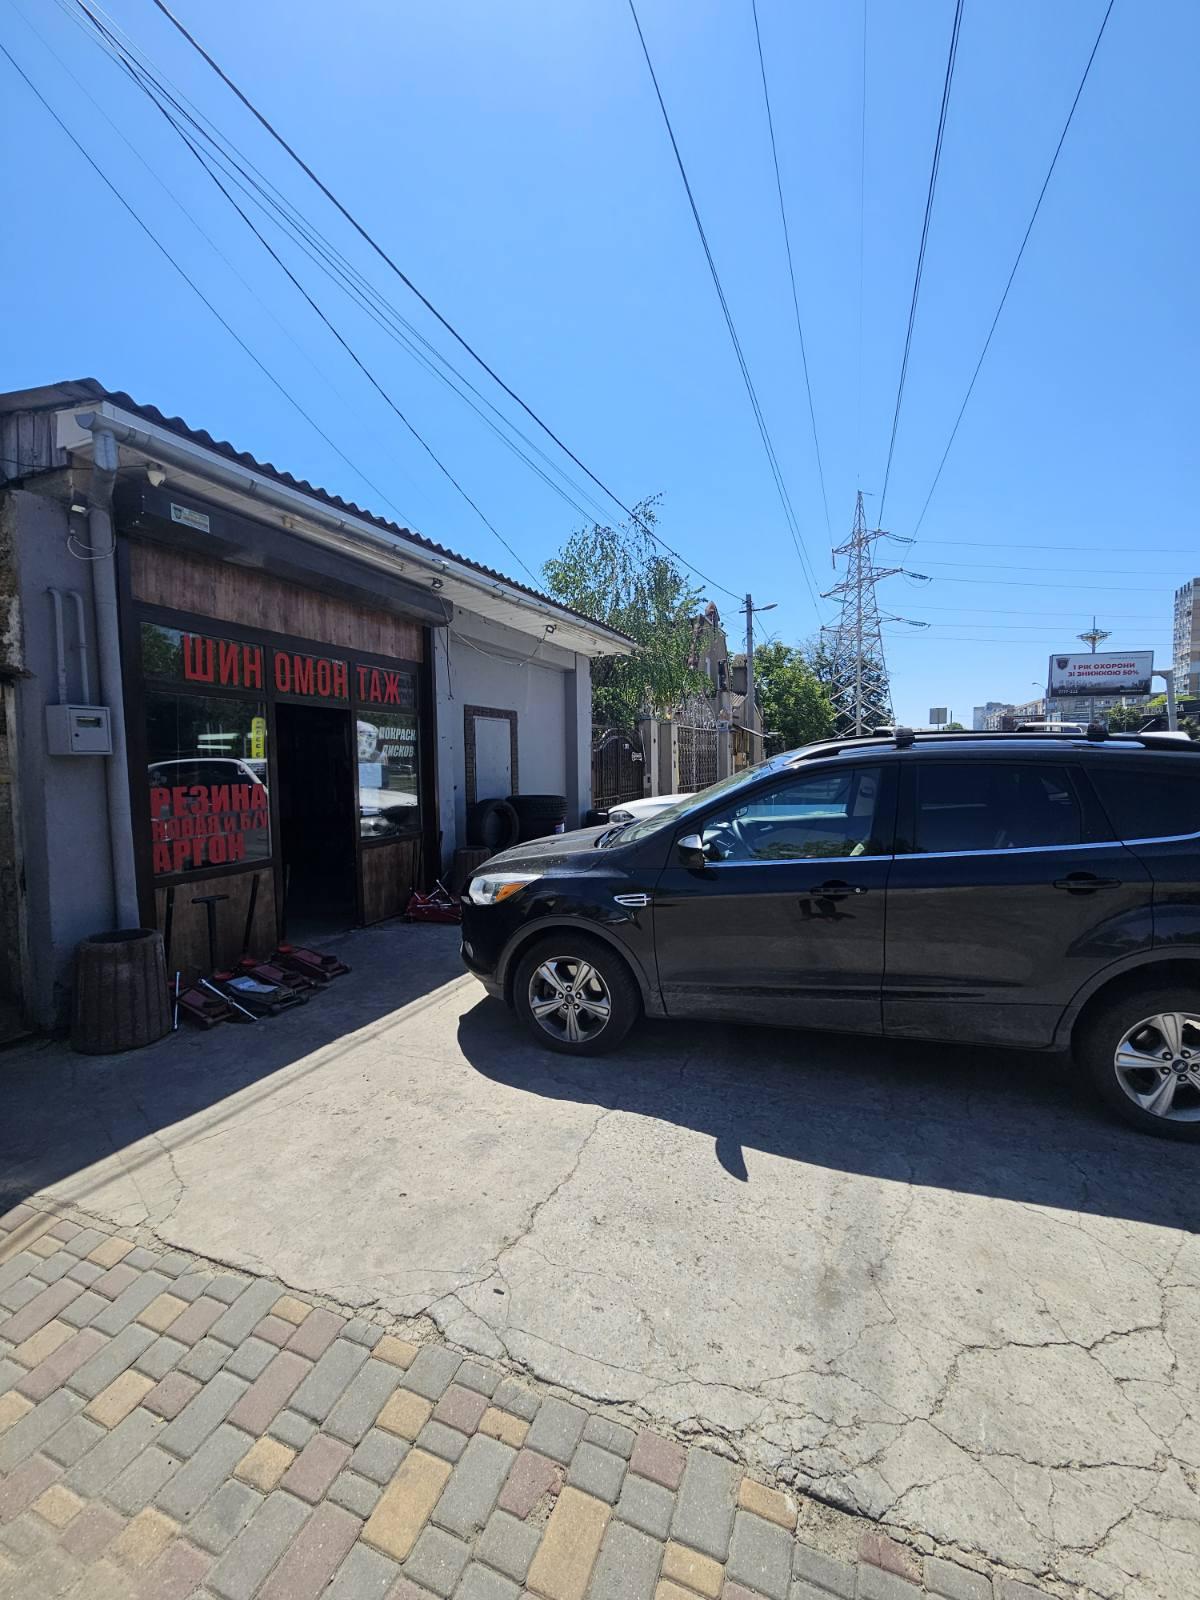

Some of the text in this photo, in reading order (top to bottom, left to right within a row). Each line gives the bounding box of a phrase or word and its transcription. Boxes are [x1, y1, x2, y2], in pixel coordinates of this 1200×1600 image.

[184, 633, 401, 704] ШИН ОМОН ТАЖ
[150, 784, 267, 817] РЕЗИНА
[152, 814, 221, 842] НОВАЯ
[153, 832, 244, 874] АРГОН
